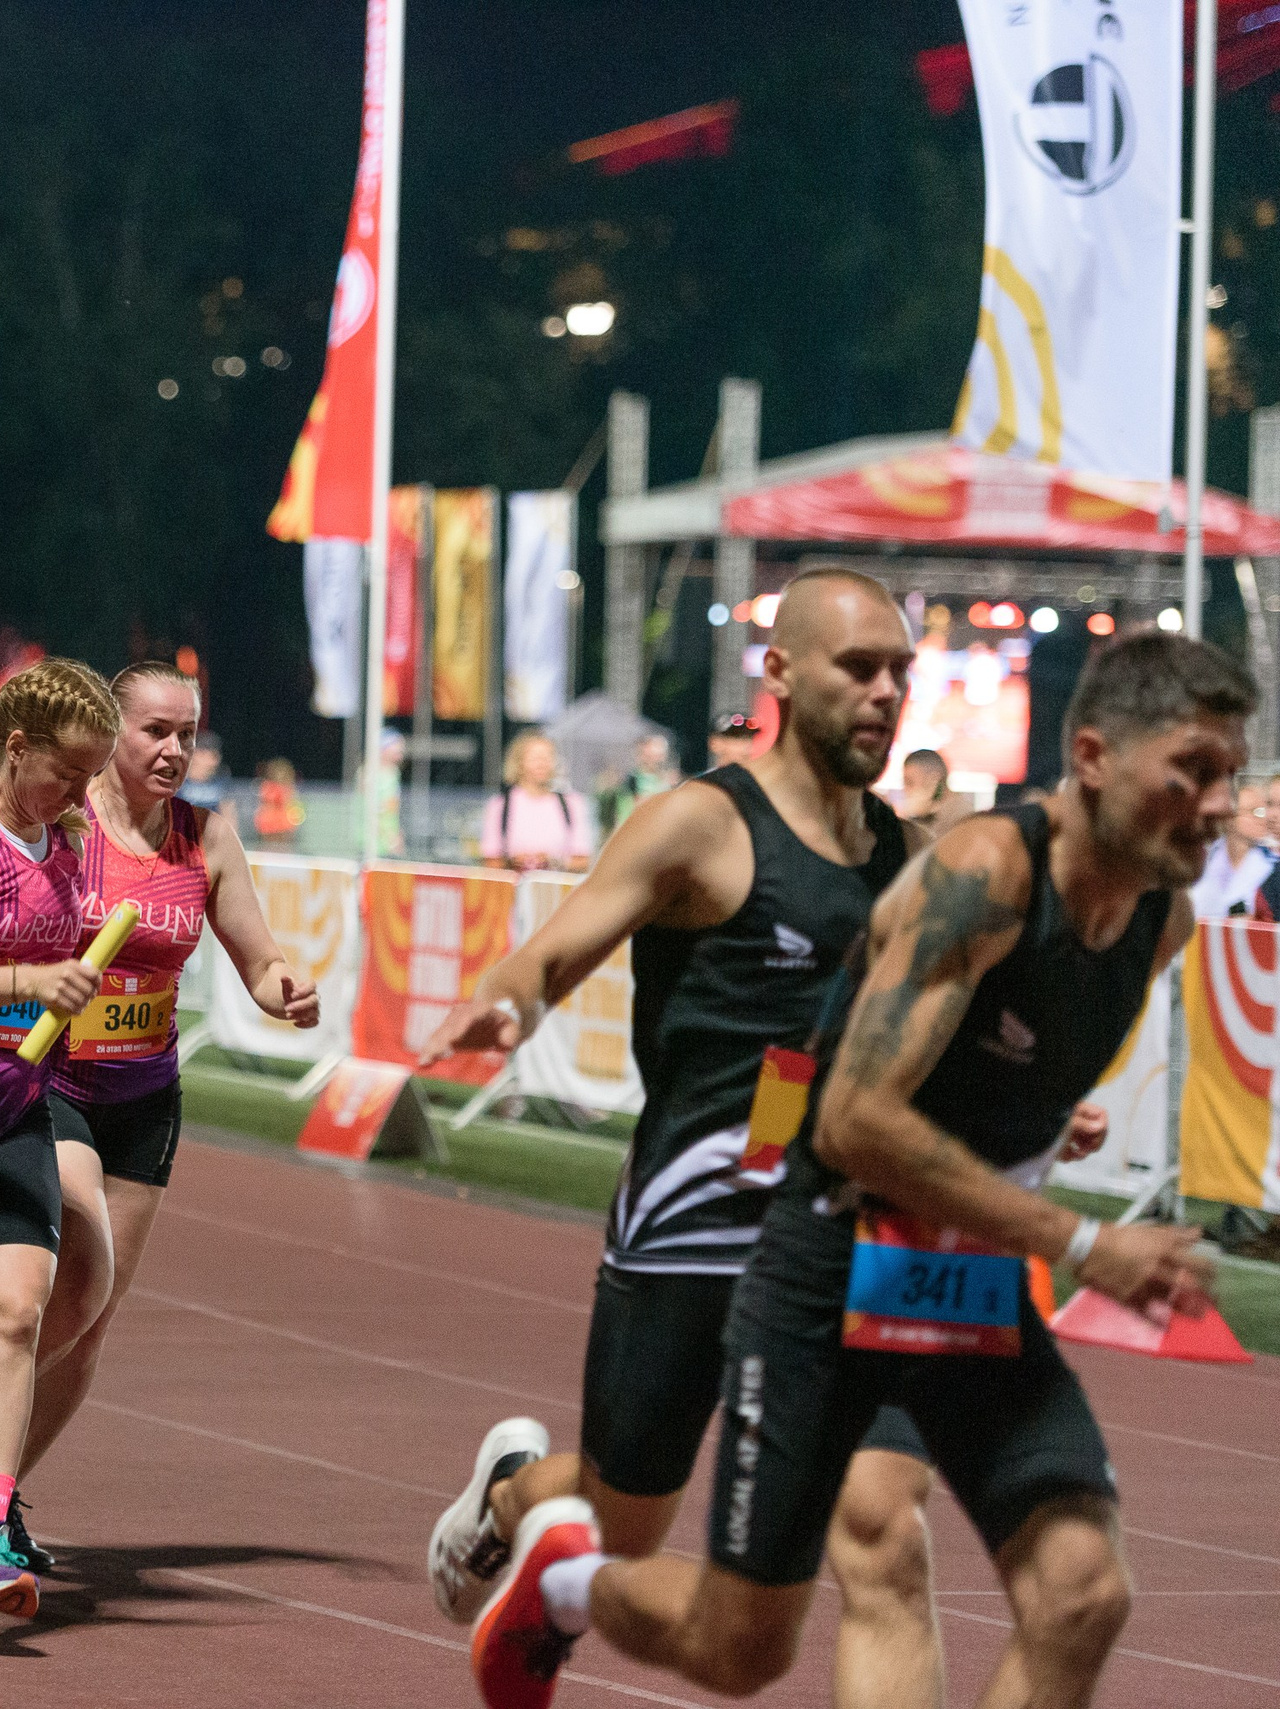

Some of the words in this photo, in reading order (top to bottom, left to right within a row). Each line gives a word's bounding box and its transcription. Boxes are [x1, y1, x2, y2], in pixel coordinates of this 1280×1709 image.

[105, 1002, 150, 1031] 340
[156, 1011, 164, 1026] 2
[902, 1263, 967, 1311] 341
